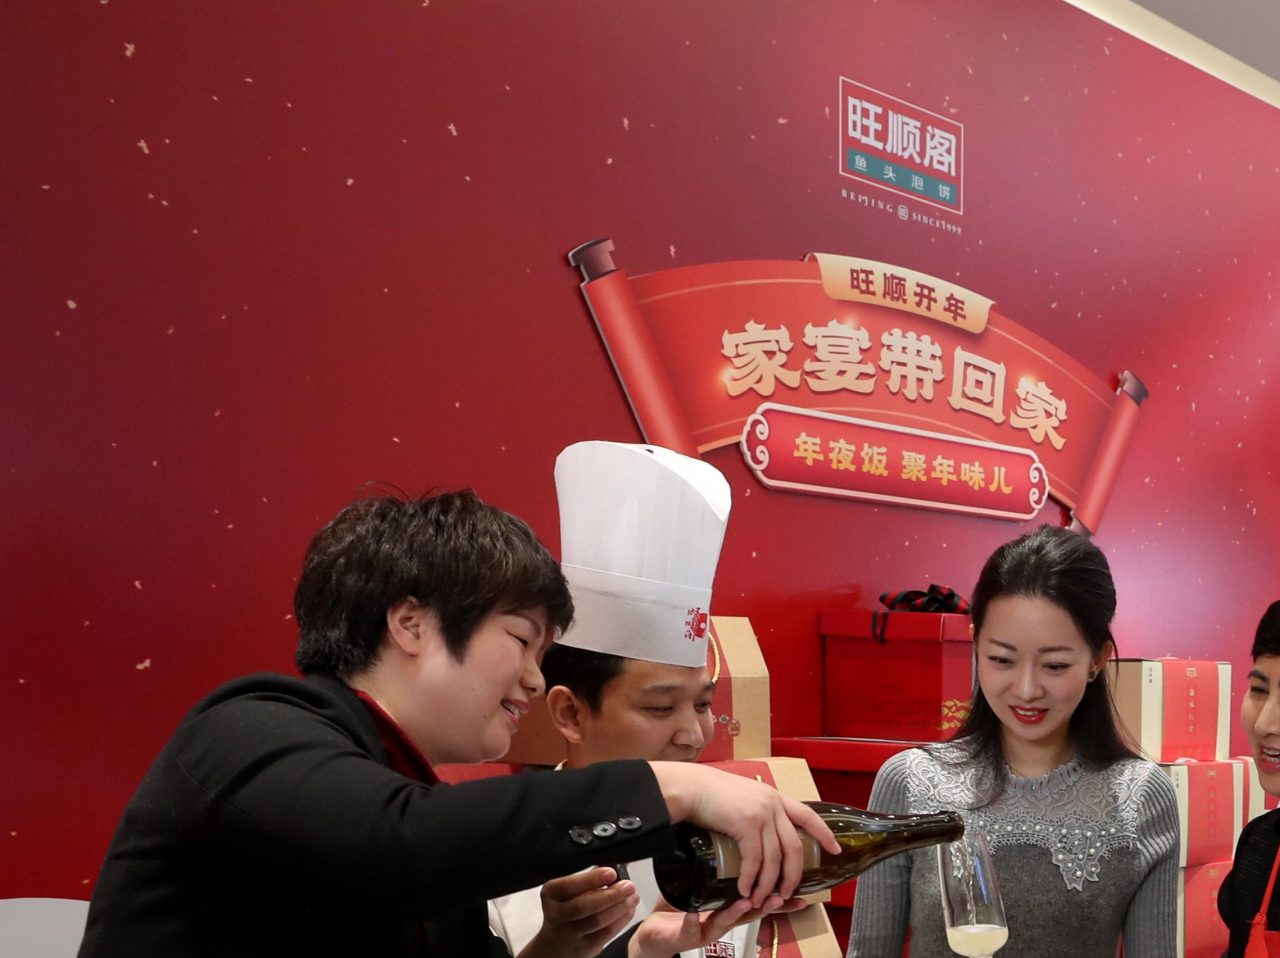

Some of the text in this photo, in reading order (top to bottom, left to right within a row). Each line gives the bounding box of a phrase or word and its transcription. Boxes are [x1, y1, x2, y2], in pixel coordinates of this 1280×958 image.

[847, 95, 957, 177] 旺顺阁
[841, 189, 894, 213] BEIJING
[854, 154, 951, 201] 鱼头泡饼
[849, 266, 968, 323] 旺顺开年
[720, 318, 1069, 451] 家宴带回家
[793, 431, 1013, 495] 年夜饭 聚年味儿
